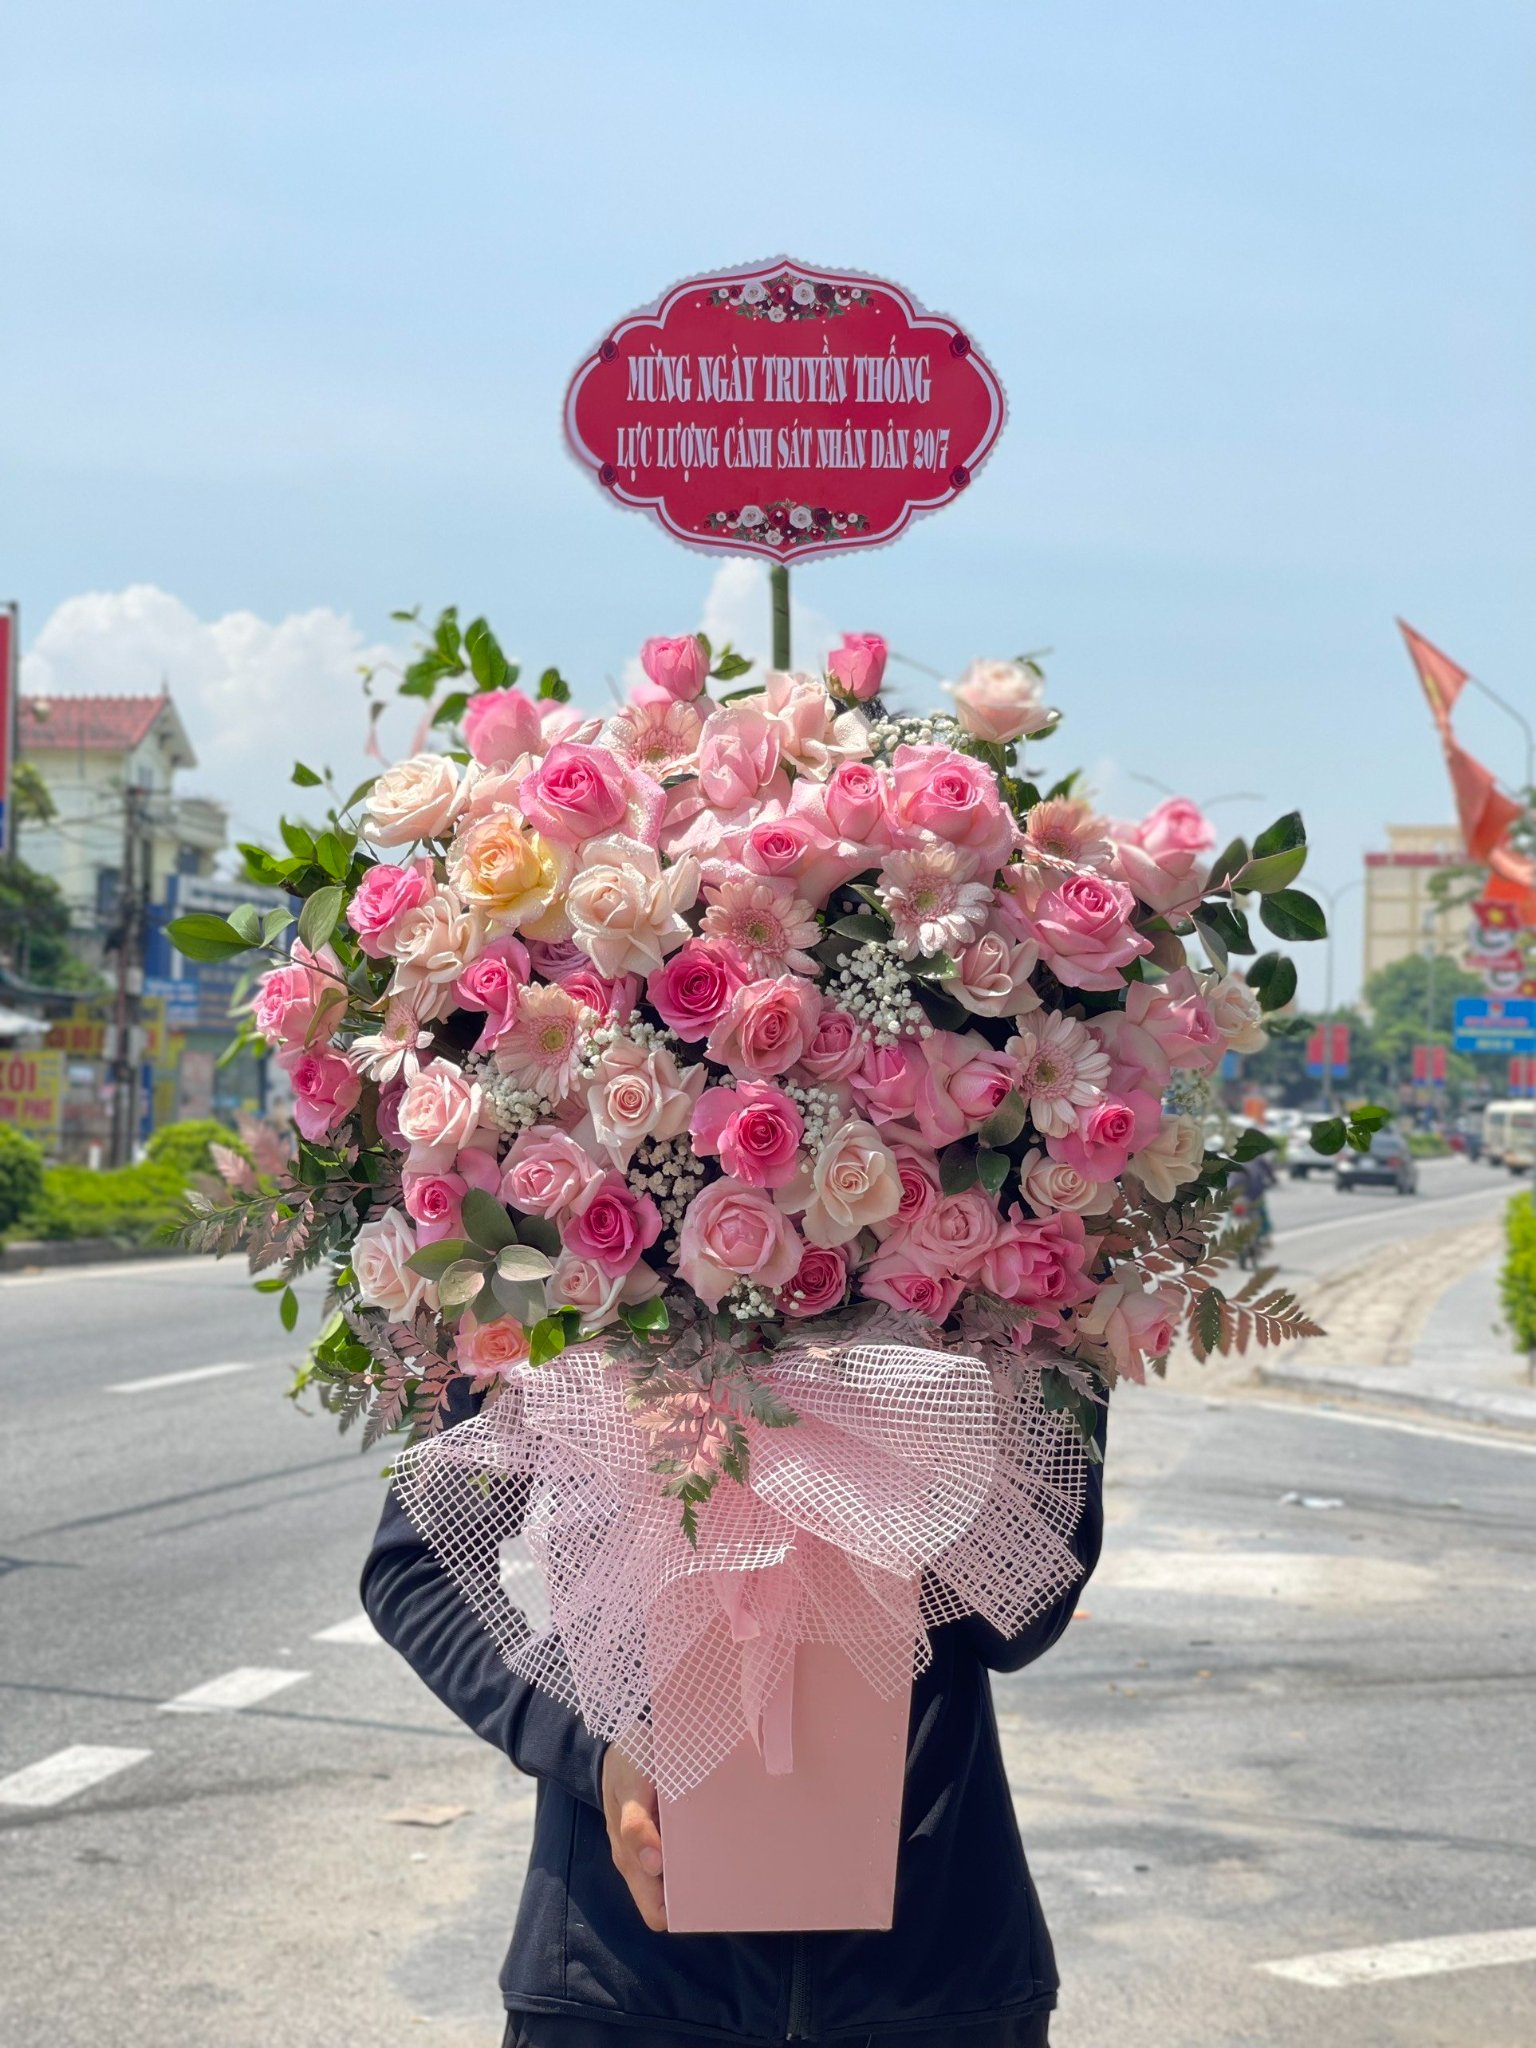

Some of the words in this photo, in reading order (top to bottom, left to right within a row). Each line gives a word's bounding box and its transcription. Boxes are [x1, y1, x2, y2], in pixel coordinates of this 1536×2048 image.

[626, 343, 693, 404] MỪNG
[697, 343, 758, 404] NGÀY
[761, 334, 849, 406] TRUYỀN
[853, 334, 932, 405] THỐNG
[616, 421, 653, 483] LỰC
[656, 421, 720, 483] LƯỢNG
[723, 416, 774, 470] CẢNH
[777, 417, 813, 471] SÁT
[815, 417, 868, 470] NHÂN
[870, 417, 910, 470] DÂN
[912, 427, 951, 474] 20/7
